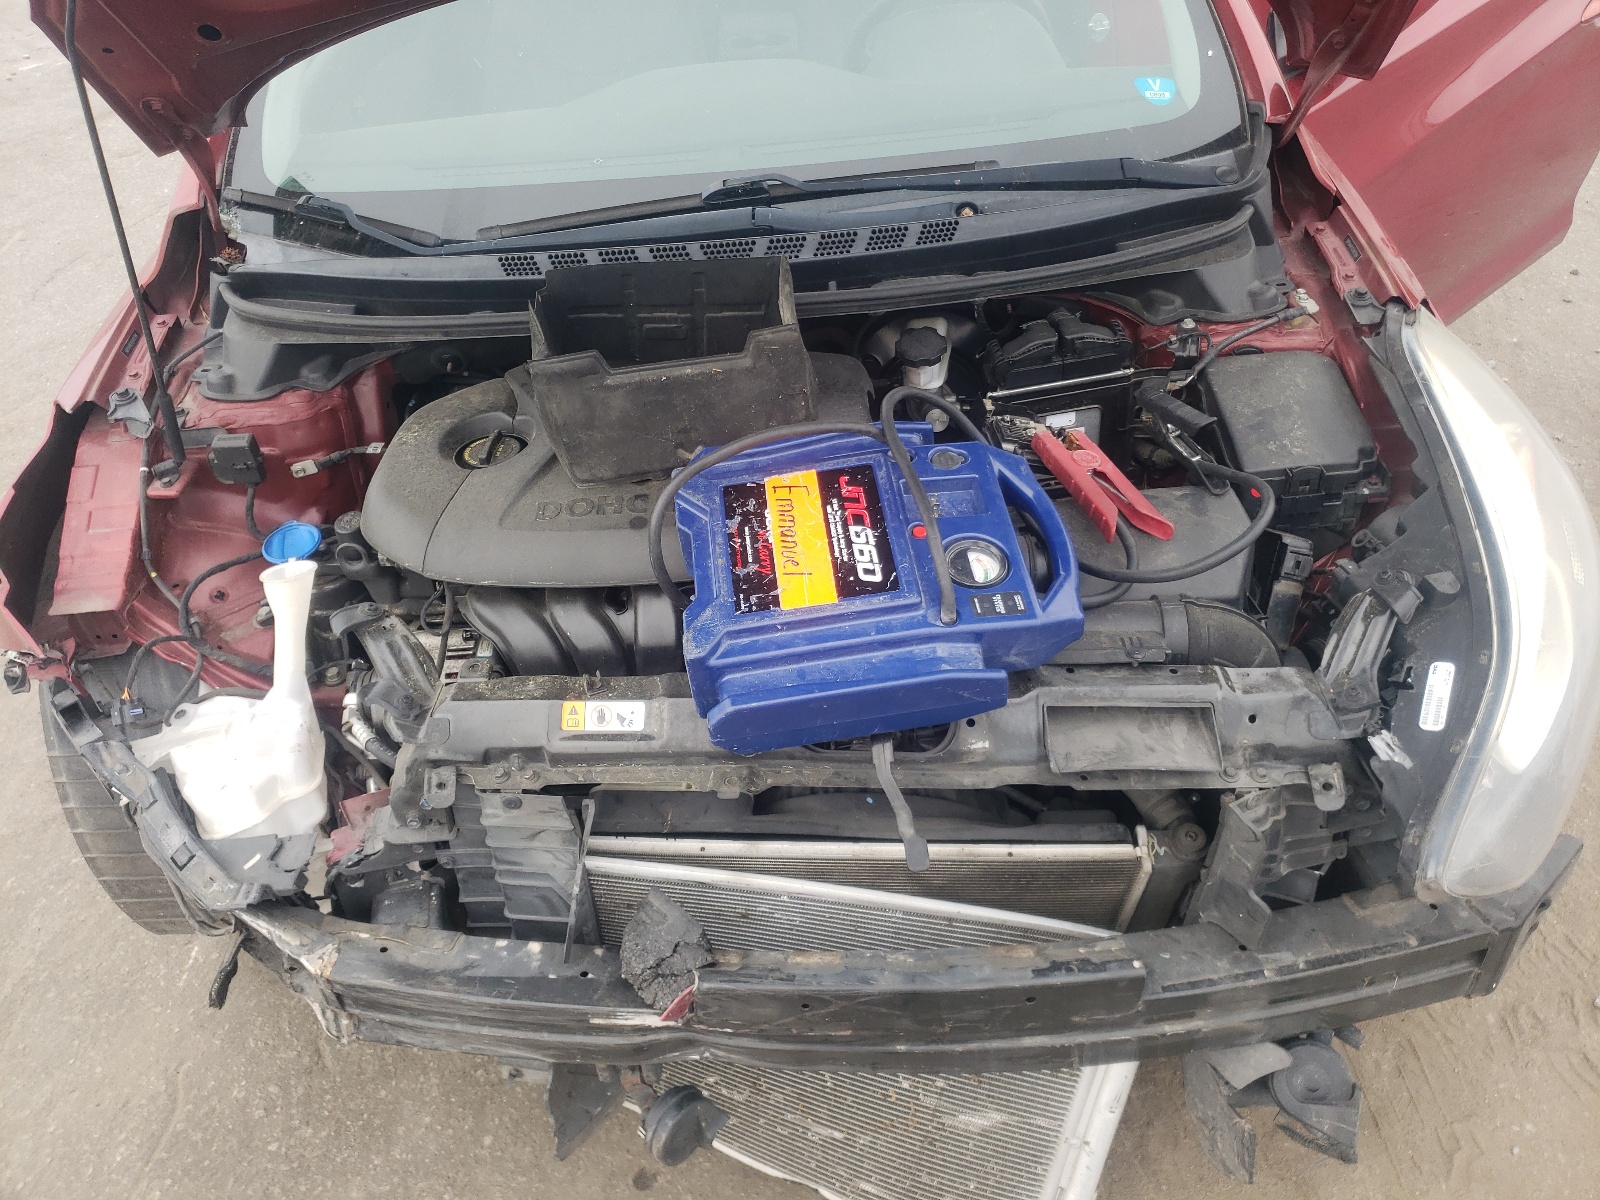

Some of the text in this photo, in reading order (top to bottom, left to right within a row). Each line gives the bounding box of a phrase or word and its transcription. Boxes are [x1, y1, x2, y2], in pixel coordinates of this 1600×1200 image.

[534, 493, 649, 521] DOHC
[771, 485, 813, 576] Emmanuel
[838, 475, 883, 583] JNC660
